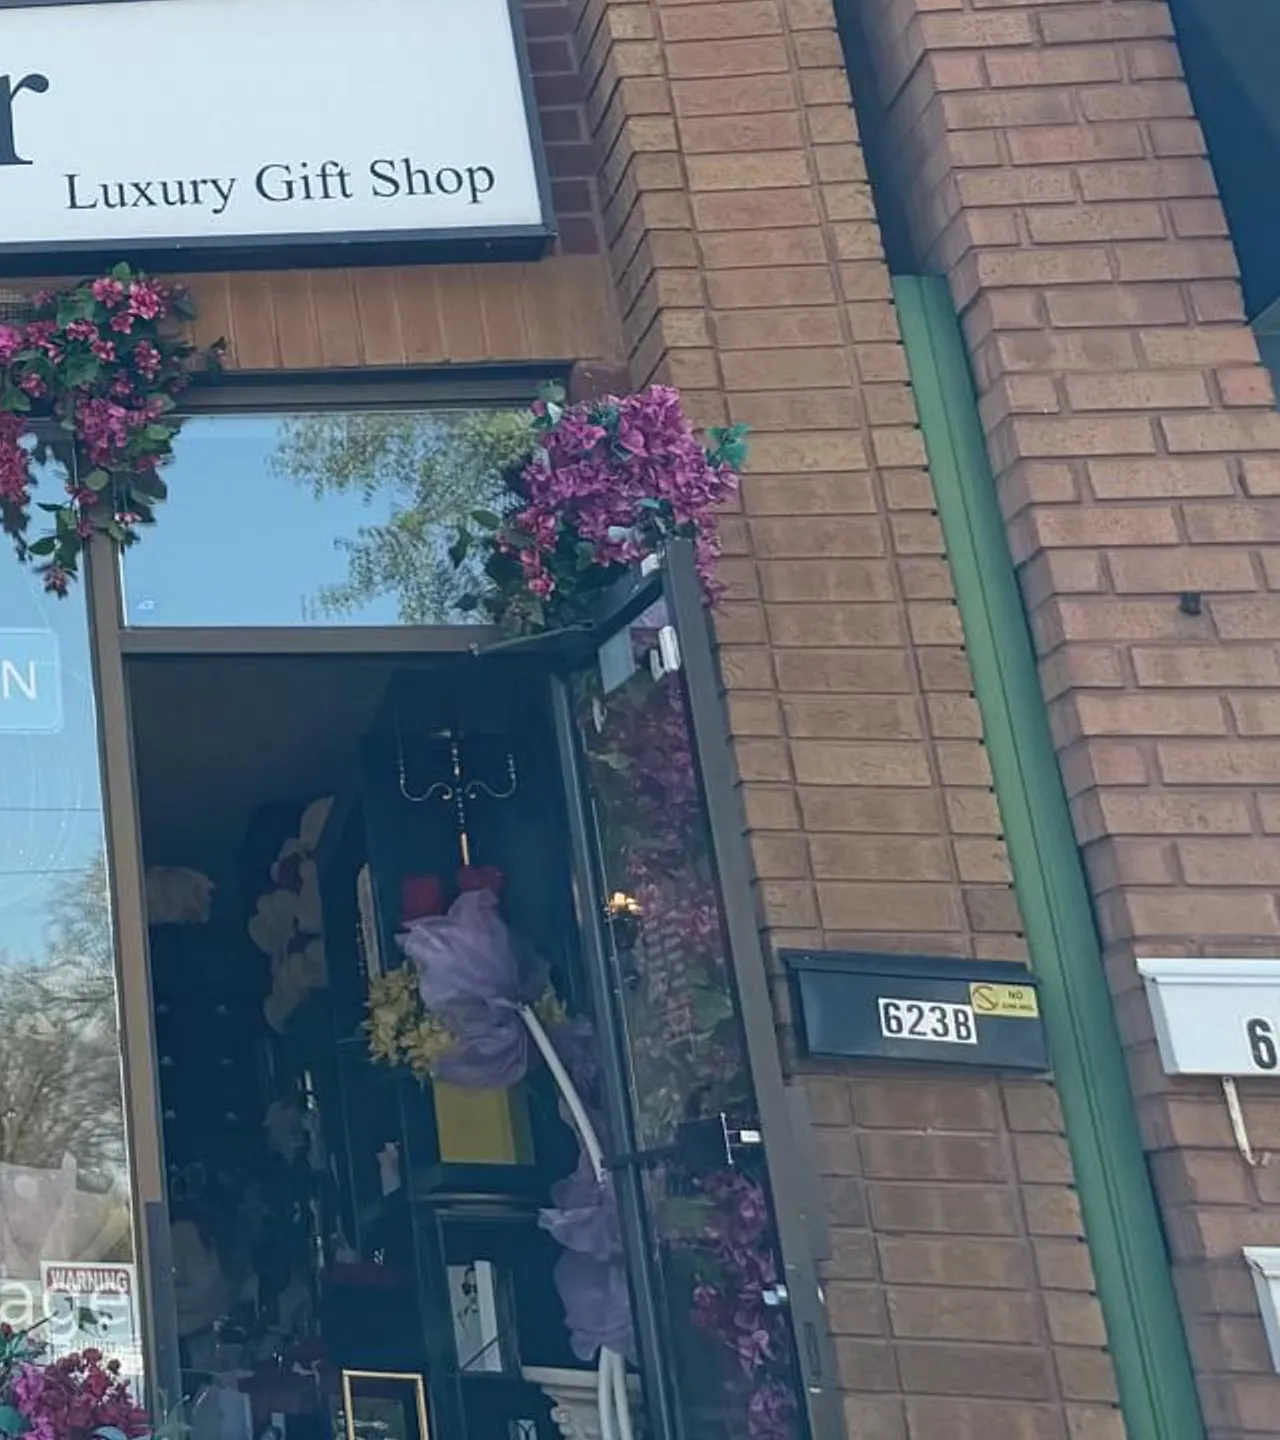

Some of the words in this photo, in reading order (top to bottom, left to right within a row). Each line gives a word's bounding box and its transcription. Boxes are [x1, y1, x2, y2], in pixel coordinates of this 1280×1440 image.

[63, 171, 236, 215] Luxury
[254, 160, 352, 202] Gift
[369, 157, 496, 205] Shop
[882, 1001, 972, 1041] 623B
[49, 1269, 129, 1293] WARNING
